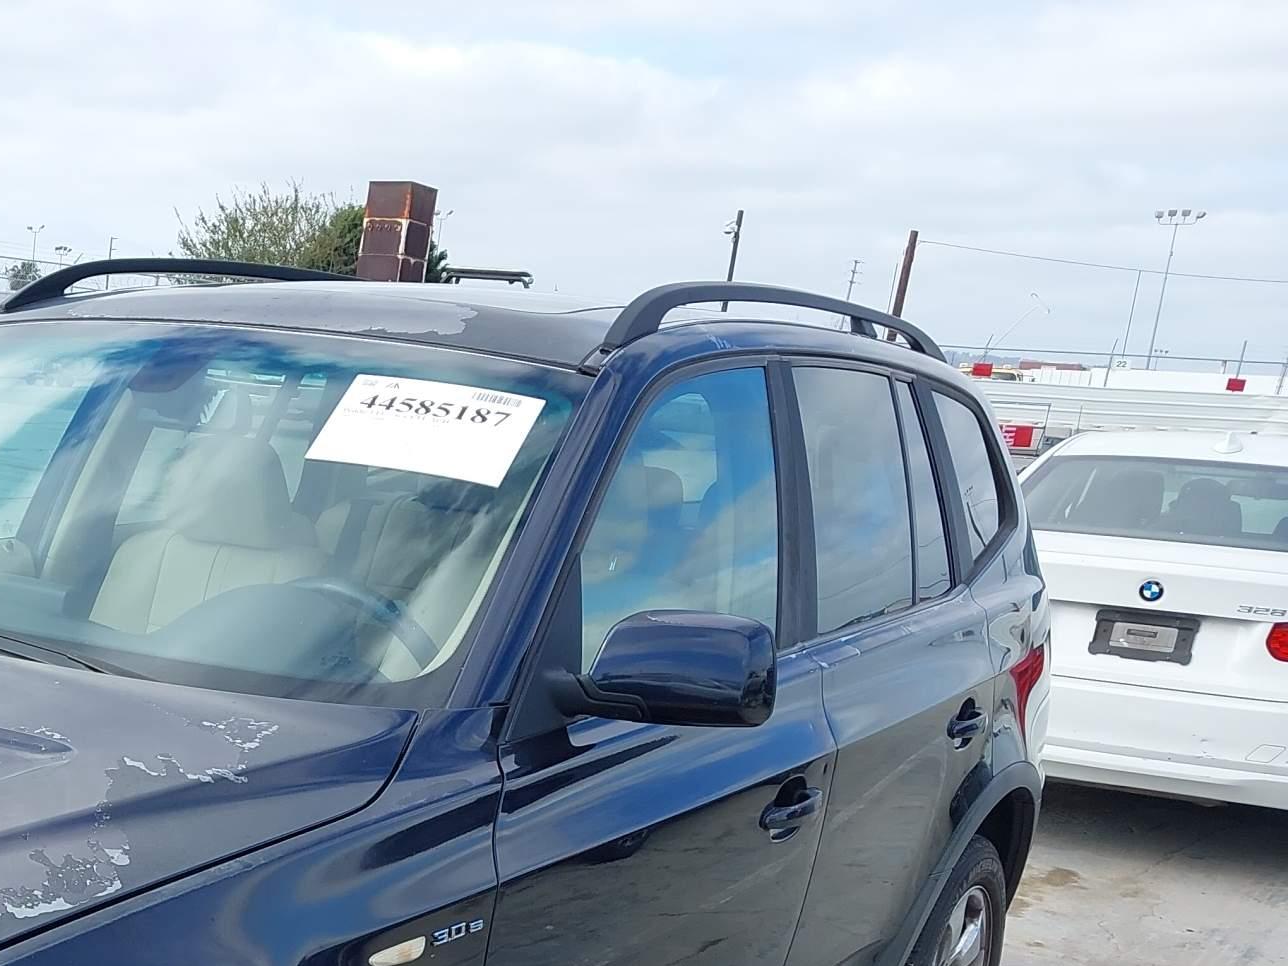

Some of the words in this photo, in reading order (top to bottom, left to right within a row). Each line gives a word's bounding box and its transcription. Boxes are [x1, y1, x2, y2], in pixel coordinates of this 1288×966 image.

[1116, 360, 1127, 368] 22
[360, 394, 512, 427] 44585187
[1236, 605, 1287, 617] 328
